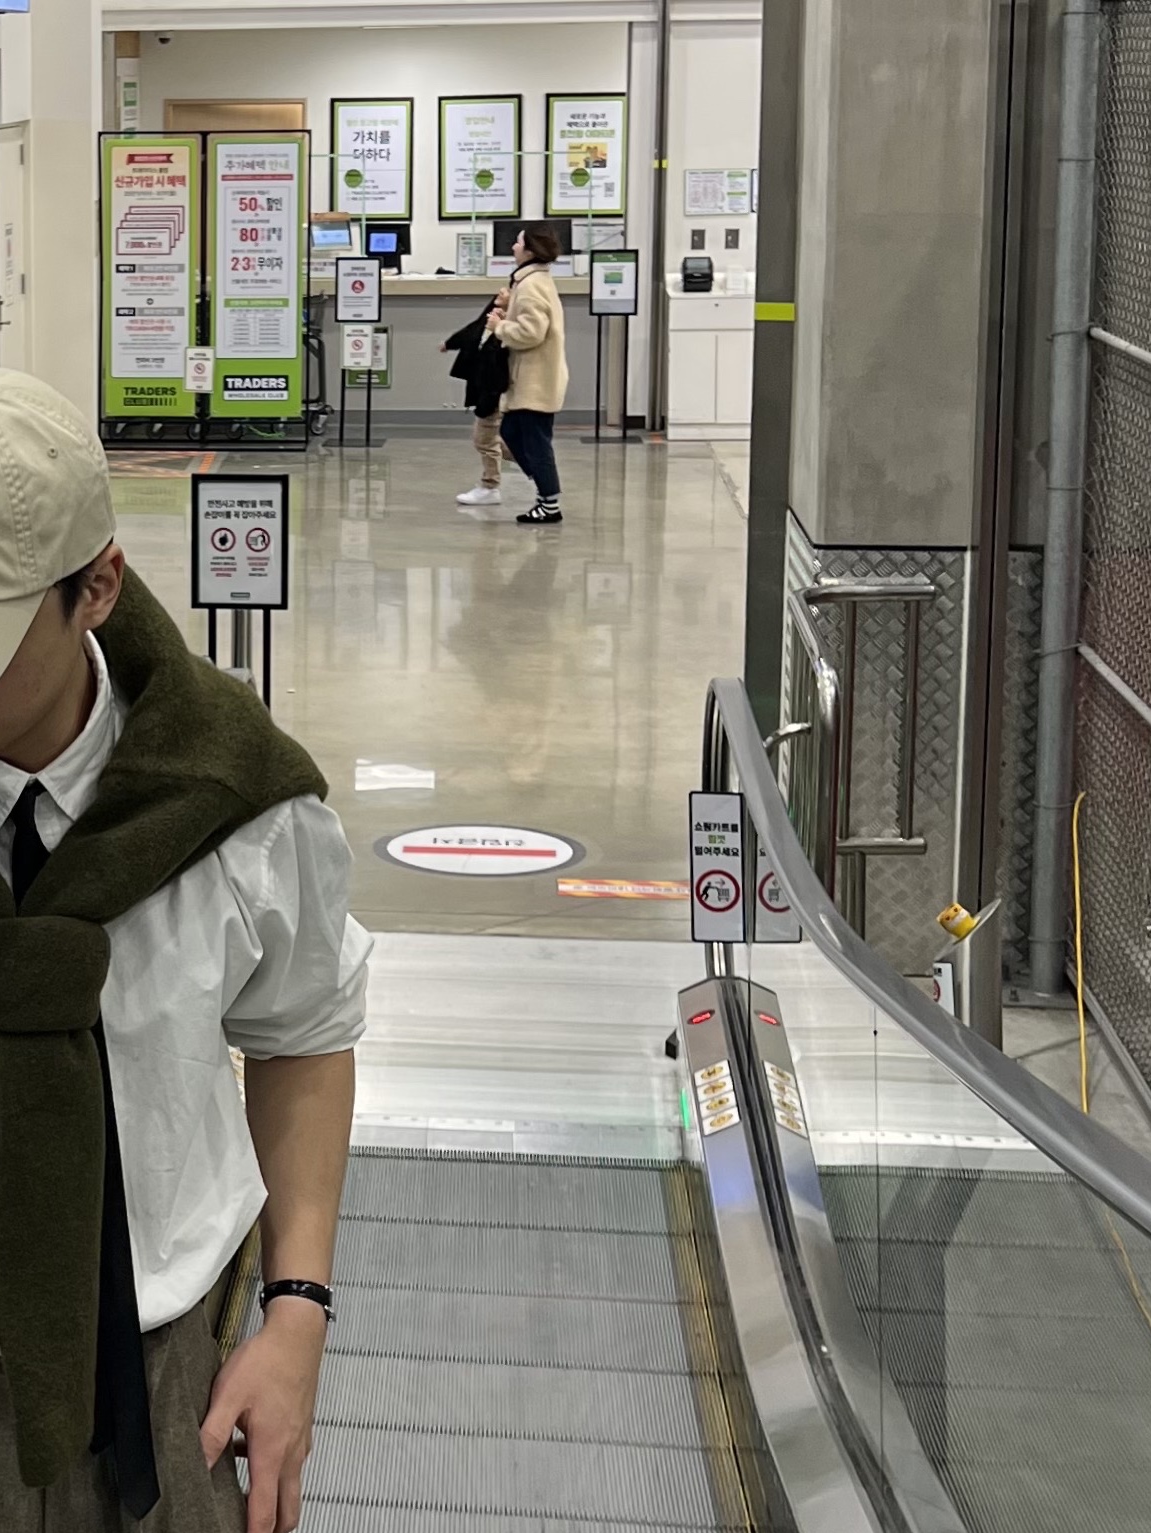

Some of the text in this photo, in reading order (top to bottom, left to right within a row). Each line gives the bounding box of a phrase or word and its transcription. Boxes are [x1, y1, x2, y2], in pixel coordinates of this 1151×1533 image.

[352, 130, 392, 145] 가치를
[352, 148, 392, 162] 더하다
[114, 175, 155, 189] 신규가입
[155, 175, 165, 188] 시
[256, 257, 284, 271] 무이자
[225, 377, 287, 389] TRADERS
[123, 386, 178, 397] TRADERS
[207, 499, 236, 509] 안전사고
[204, 510, 232, 520] 손잡이를
[241, 510, 277, 520] 잡아주세요
[693, 821, 739, 833] 쇼핑카트를
[694, 845, 740, 857] 밀어주세요
